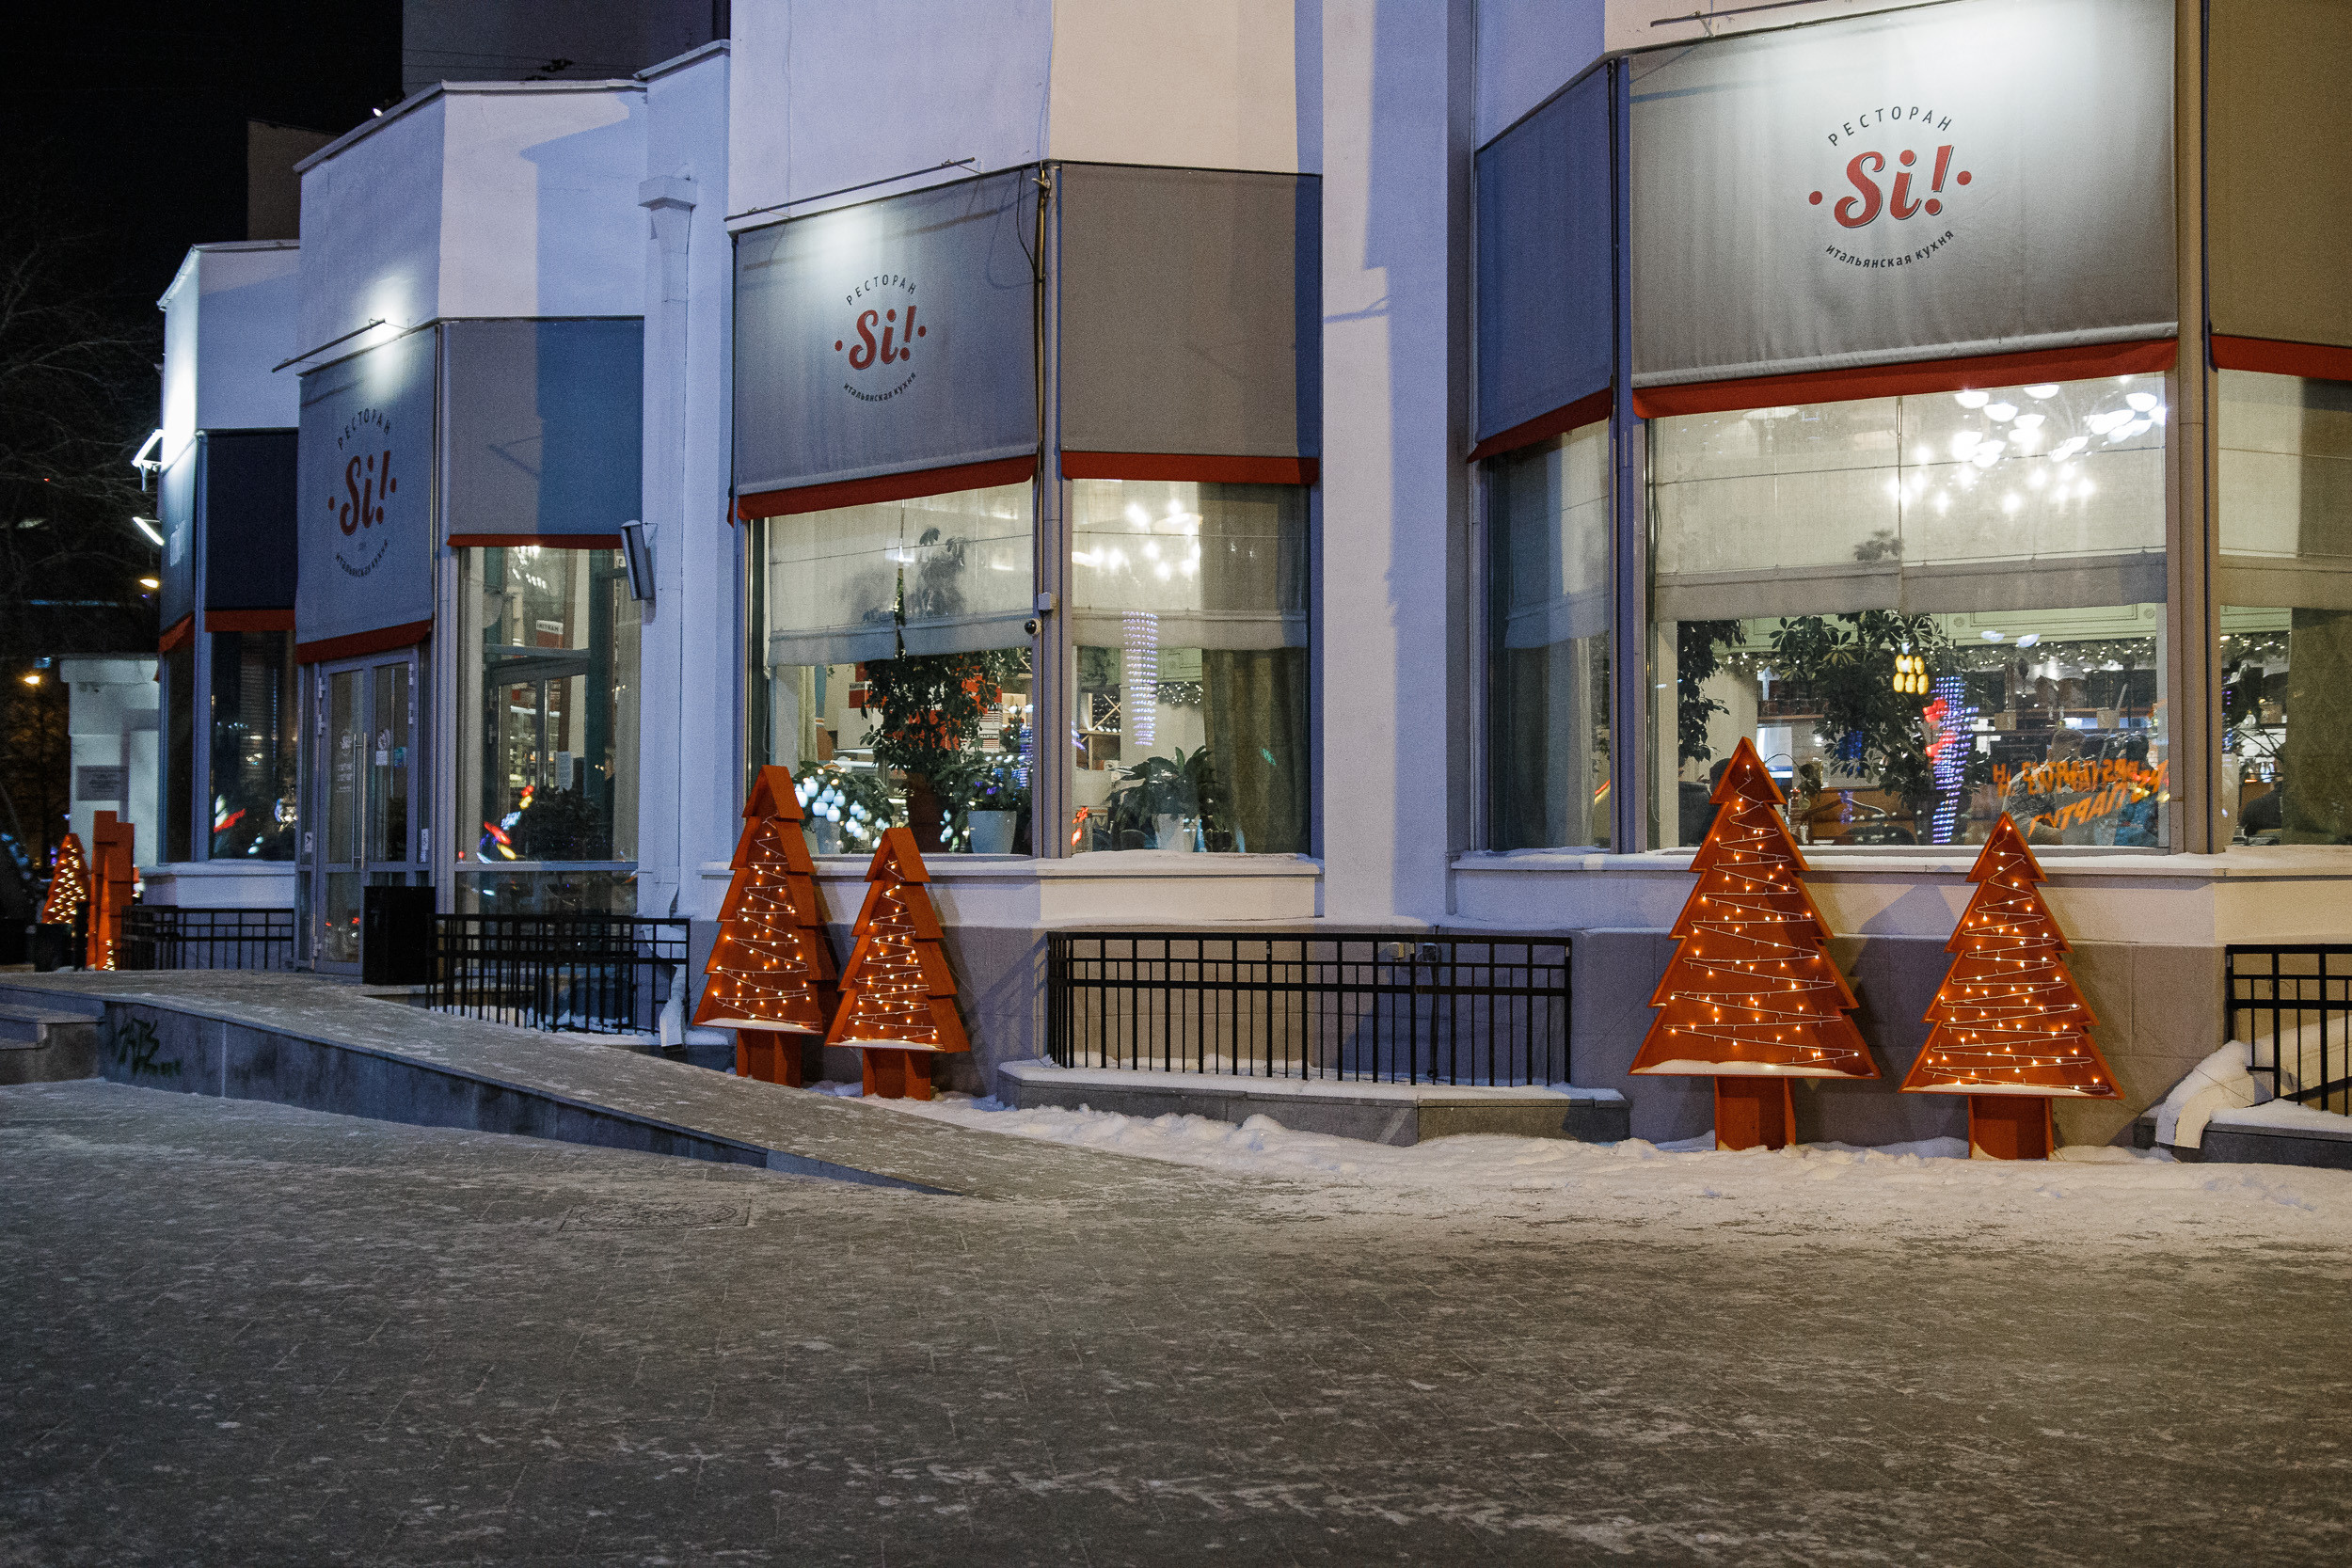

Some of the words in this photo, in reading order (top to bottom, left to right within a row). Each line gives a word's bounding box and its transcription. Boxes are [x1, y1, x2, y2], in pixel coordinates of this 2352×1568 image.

[1827, 105, 1952, 147] РЕСТОРАН
[1834, 144, 1955, 229] Si!
[1825, 244, 1913, 269] итальянская
[1915, 230, 1955, 260] кухня
[846, 274, 917, 306] РЕСТОРАН
[849, 305, 917, 370] Si!
[843, 382, 893, 403] итальянская
[894, 372, 916, 395] кухня
[337, 407, 391, 451] РЕСТОРАН
[340, 451, 391, 536] Si!
